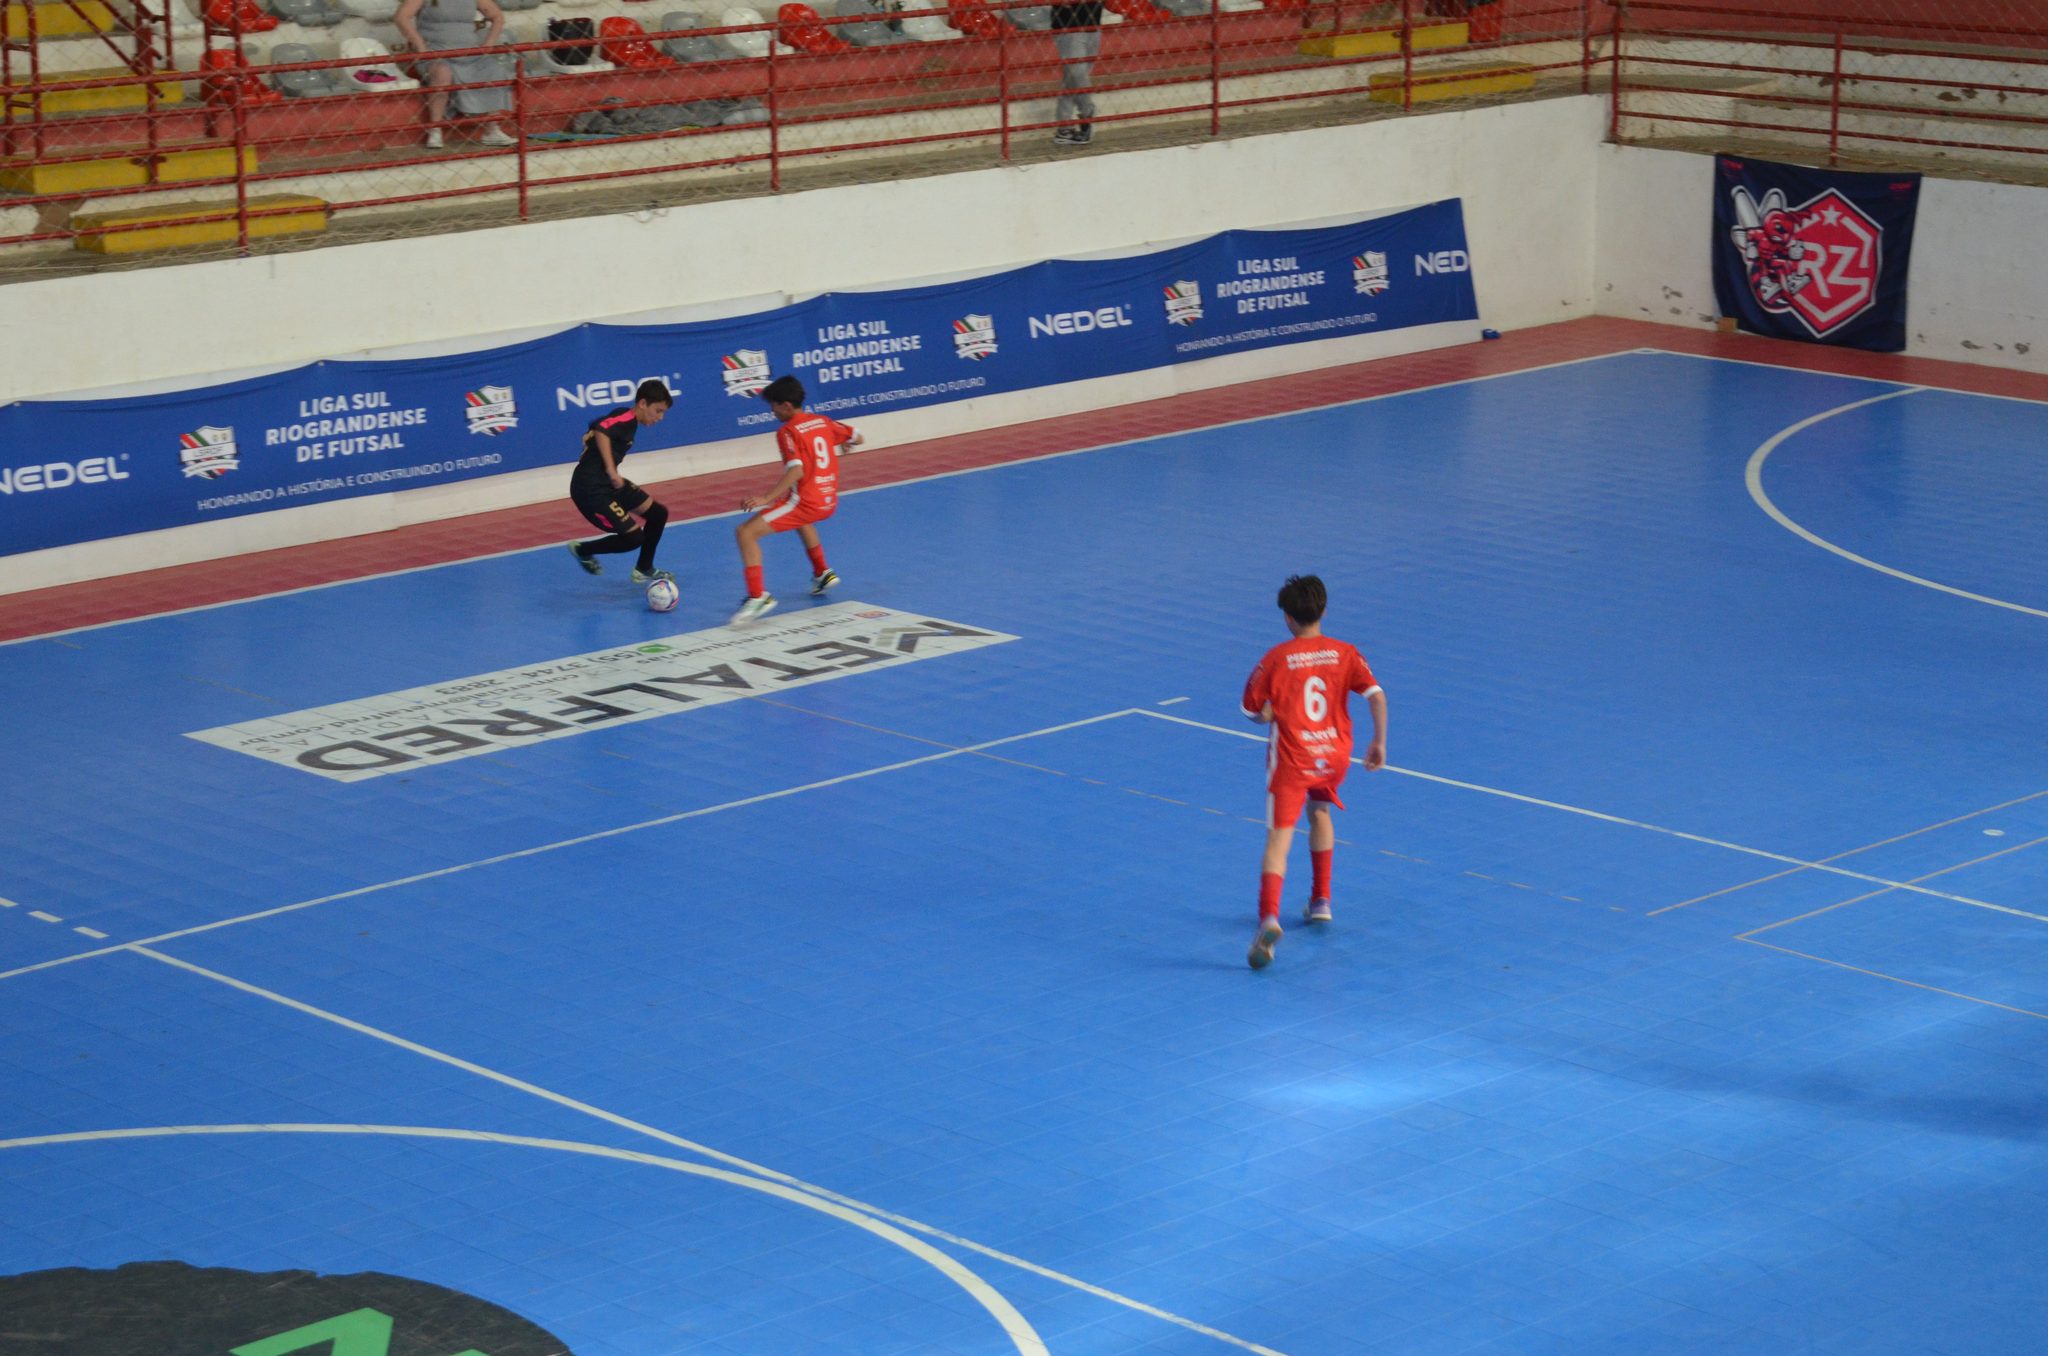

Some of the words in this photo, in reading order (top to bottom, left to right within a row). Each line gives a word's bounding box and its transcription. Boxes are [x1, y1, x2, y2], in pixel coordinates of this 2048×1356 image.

[1238, 259, 1272, 275] LIGA
[1272, 257, 1300, 272] SUL
[1415, 250, 1468, 276] NED
[1217, 271, 1325, 298] RIOGRANDENSE
[1237, 298, 1257, 314] DE
[1258, 292, 1310, 311] FUTSAL
[818, 323, 857, 343] LIGA
[858, 320, 891, 337] SUL
[1028, 306, 1133, 339] NEDEL
[792, 335, 922, 368] RIOGRANDENSE
[818, 366, 841, 383] DE
[842, 357, 905, 379] FUTSAL
[300, 395, 349, 418] LIGA
[352, 391, 391, 410] SUL
[556, 375, 682, 411] NEDL
[737, 411, 776, 426] HONRA
[937, 383, 947, 392] O
[265, 407, 427, 446] RIOGRANDENSE
[296, 443, 325, 463] DE
[327, 432, 405, 458] FUTSAL
[813, 436, 830, 469] 9
[197, 488, 274, 510] HONRANDO
[275, 487, 287, 498] A
[287, 477, 345, 496] HISTÓRIA
[346, 475, 355, 486] E
[356, 462, 443, 485] CONSTRUINDO
[443, 461, 456, 472] O
[456, 453, 503, 470] FUTURO
[608, 501, 625, 517] 5
[518, 660, 584, 680] 3744
[588, 648, 639, 666] (55)
[297, 620, 1000, 771] METALFRED
[434, 677, 498, 696] 2883
[1304, 675, 1328, 722] 6
